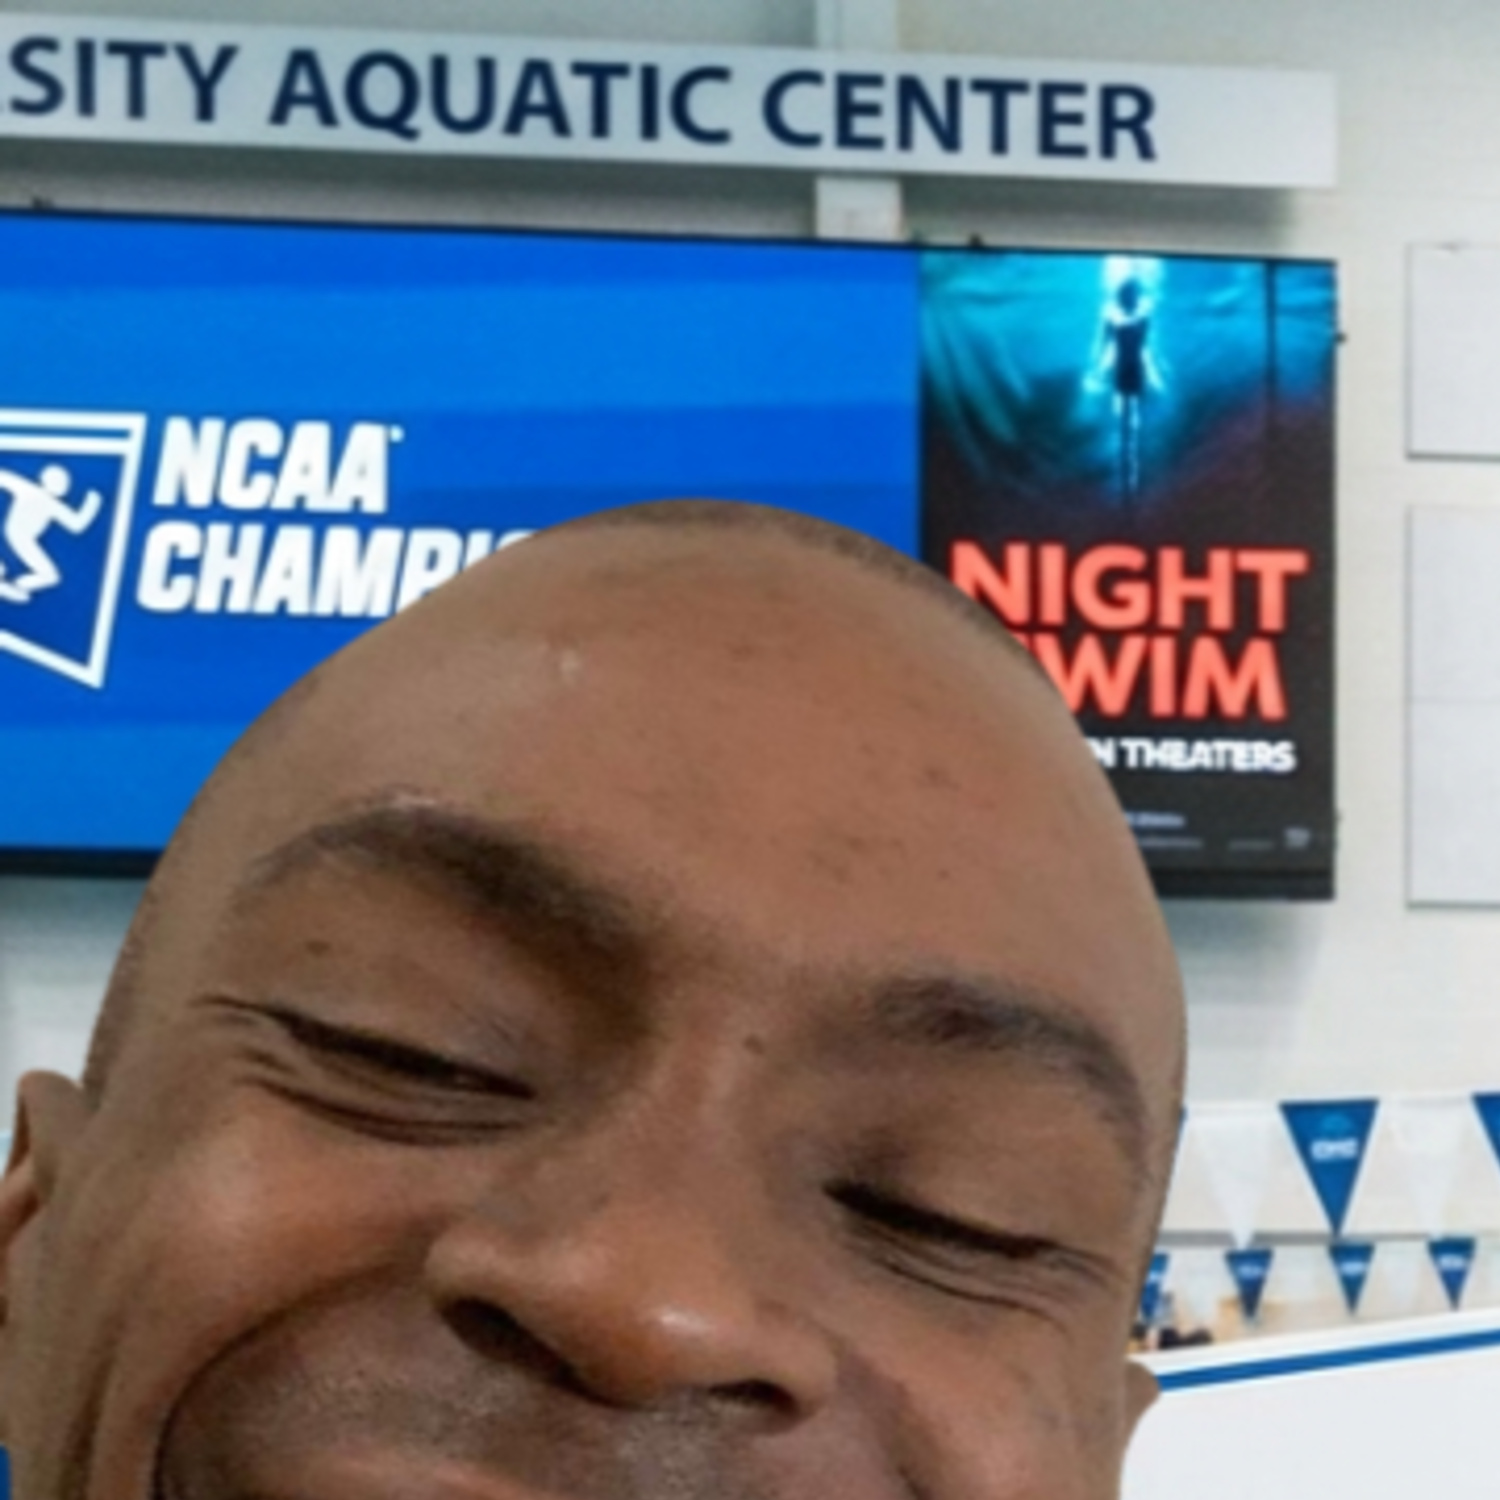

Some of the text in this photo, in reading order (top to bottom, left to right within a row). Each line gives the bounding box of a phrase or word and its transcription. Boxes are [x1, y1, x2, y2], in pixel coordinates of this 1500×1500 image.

[8, 36, 1157, 162] SITY AQUATIC CENTER
[153, 416, 390, 514] NCAA
[136, 519, 537, 618] CHAMP
[949, 540, 1309, 633] NIGHT
[1012, 631, 1287, 720] WIM
[1120, 738, 1297, 773] THEATERS
